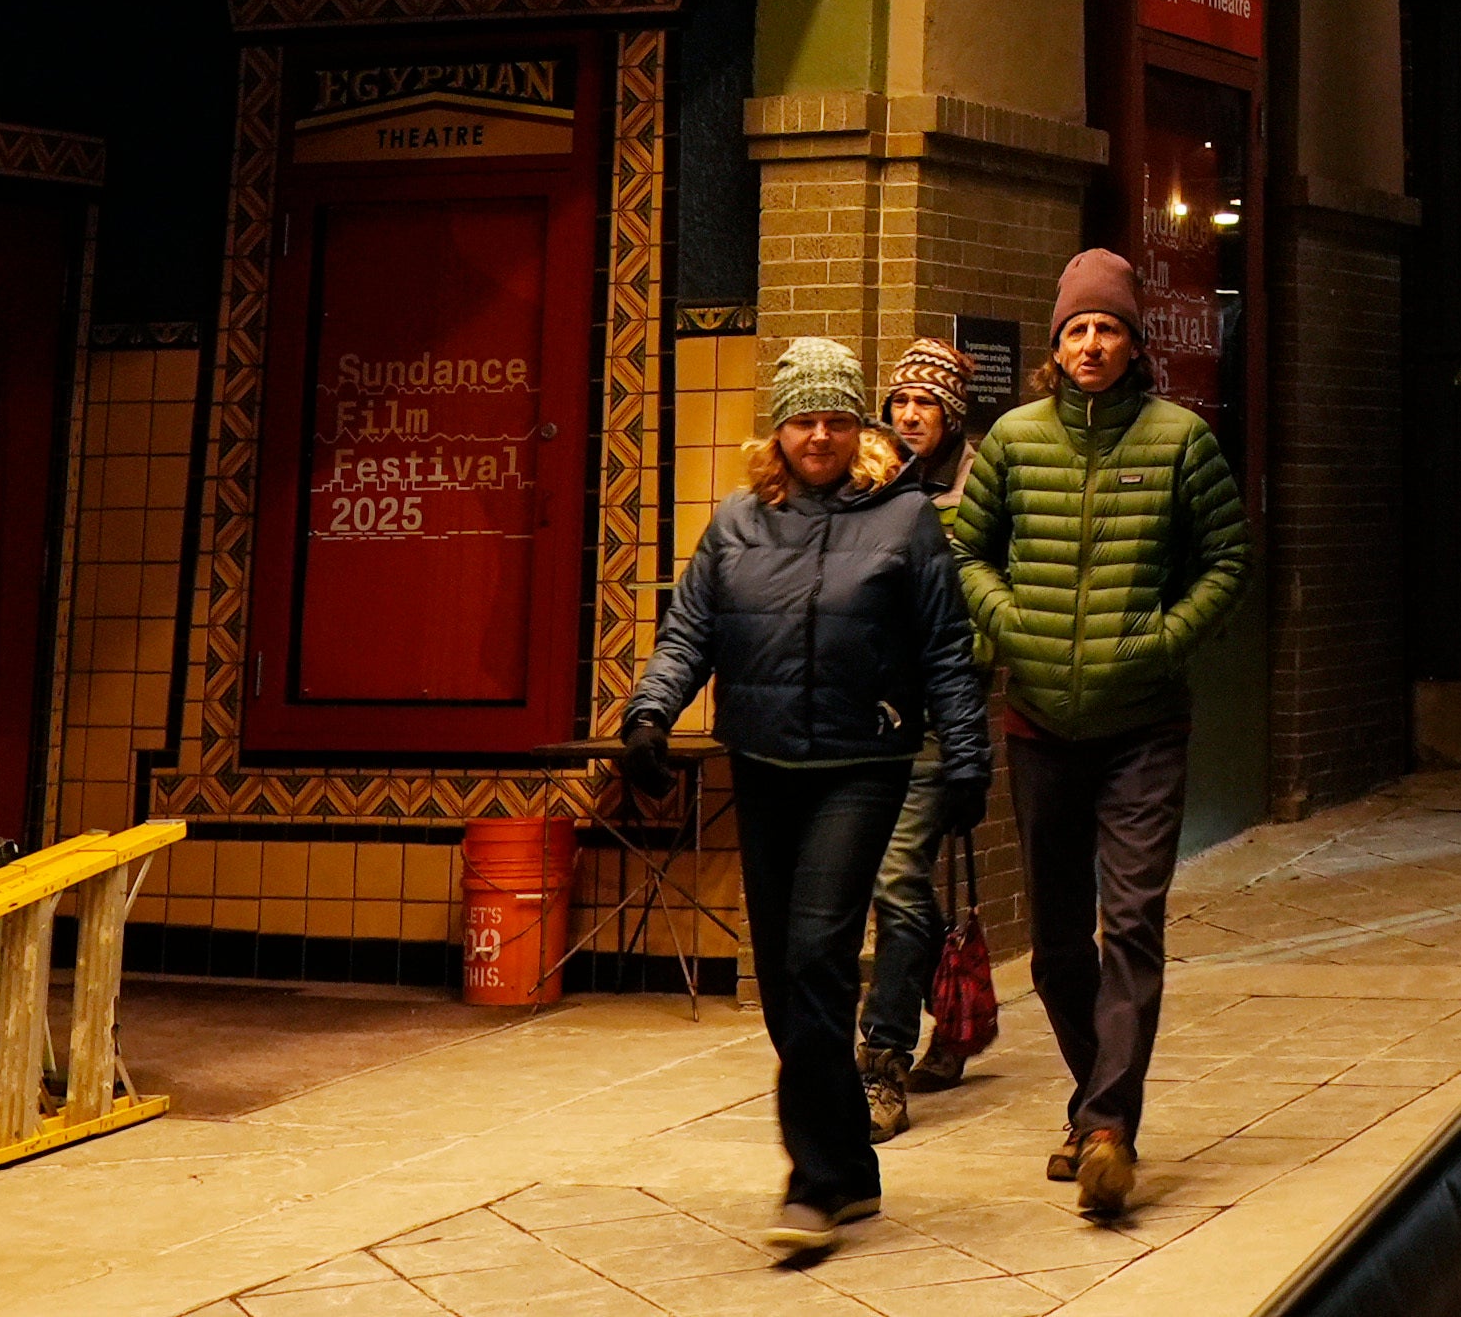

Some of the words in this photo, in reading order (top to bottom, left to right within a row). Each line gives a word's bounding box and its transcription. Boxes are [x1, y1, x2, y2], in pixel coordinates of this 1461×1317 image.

[311, 60, 559, 112] EGYPTIAN
[377, 125, 484, 149] THEATRE
[337, 351, 528, 387] Sundance
[337, 399, 430, 434] Film
[332, 445, 518, 483] Festival
[329, 496, 423, 532] 2025
[467, 906, 502, 925] ET'S
